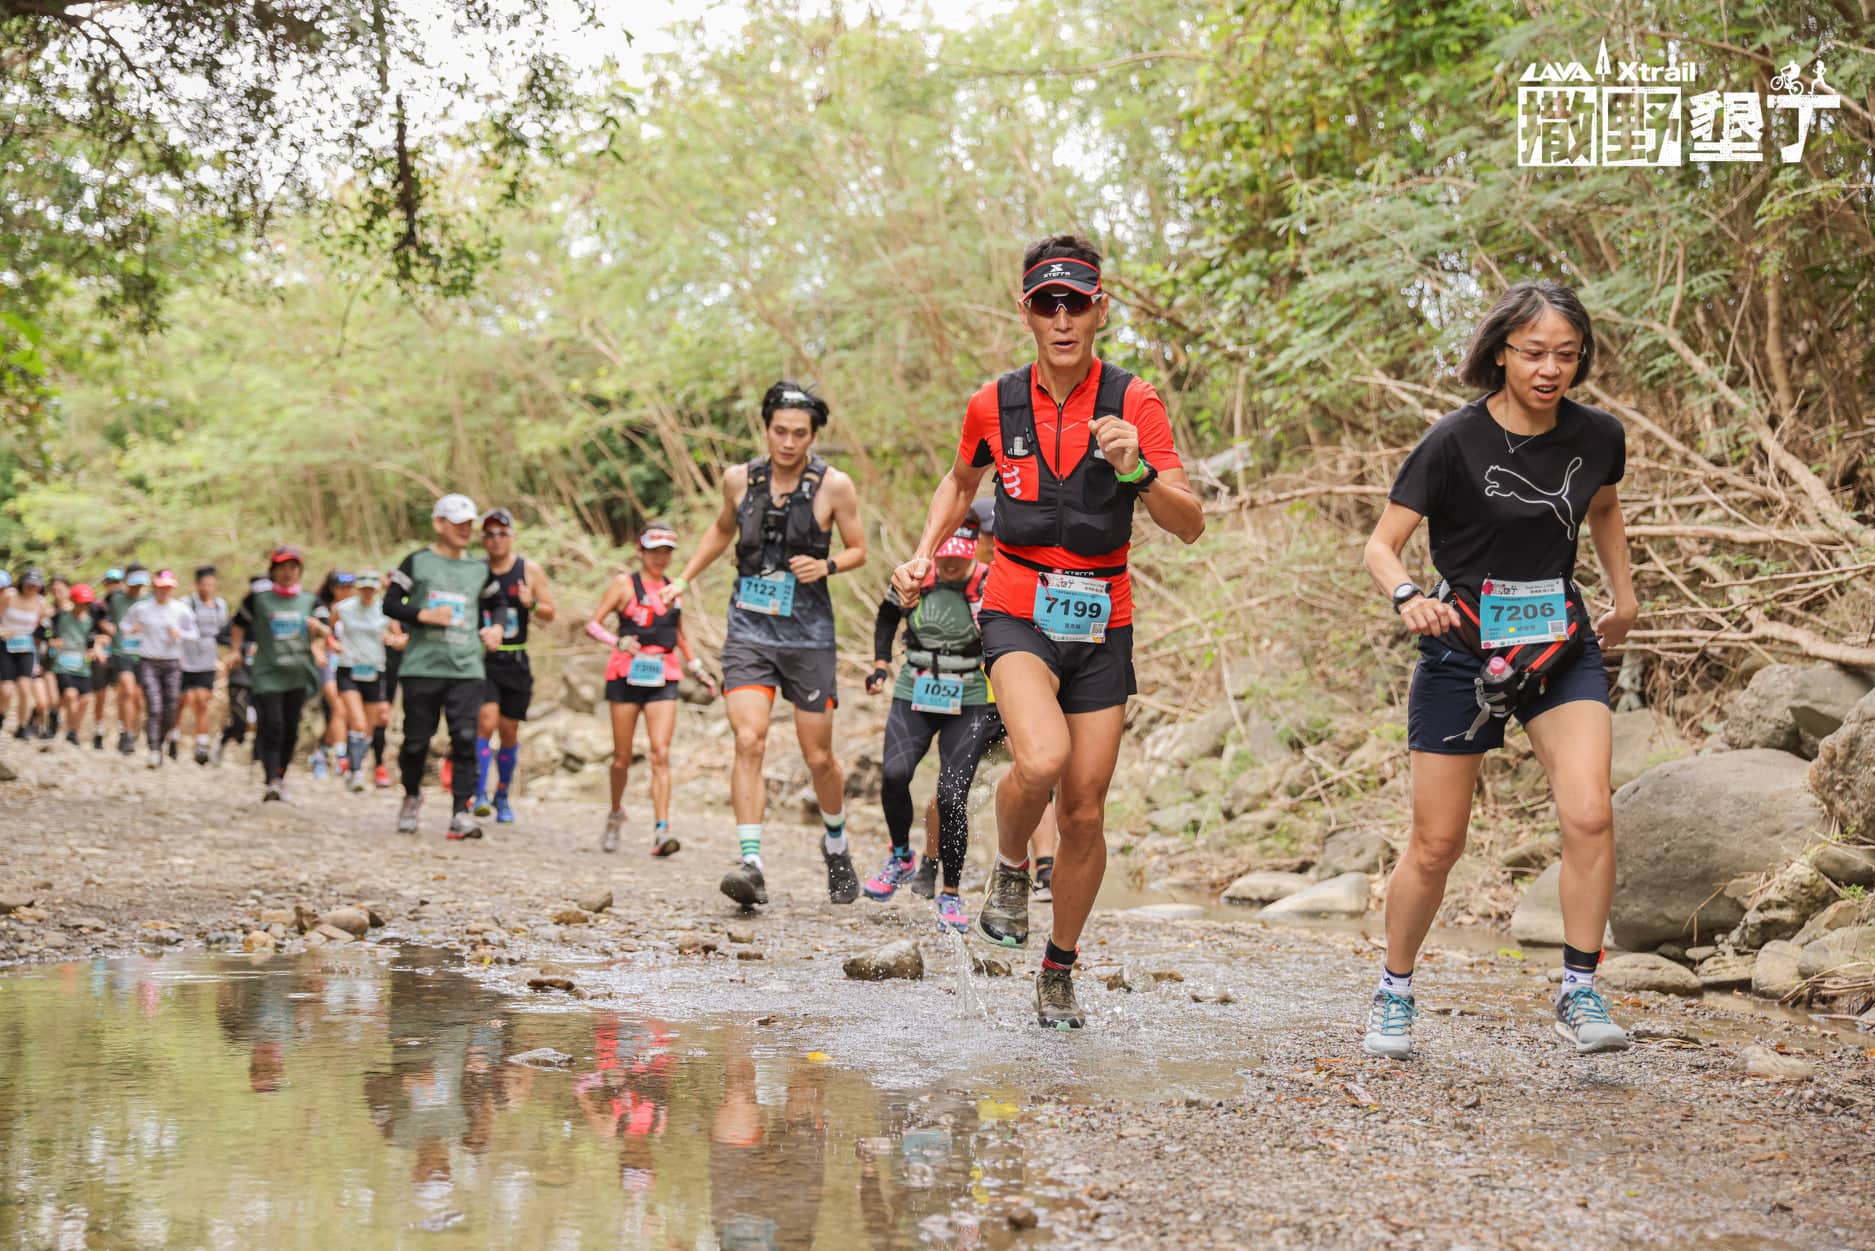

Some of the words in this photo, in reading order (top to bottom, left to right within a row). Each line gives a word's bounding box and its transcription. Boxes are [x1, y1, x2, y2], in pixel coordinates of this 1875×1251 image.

[745, 580, 777, 597] 7122
[1045, 596, 1102, 619] 7199
[1489, 602, 1555, 623] 7206
[925, 683, 960, 697] 1052
